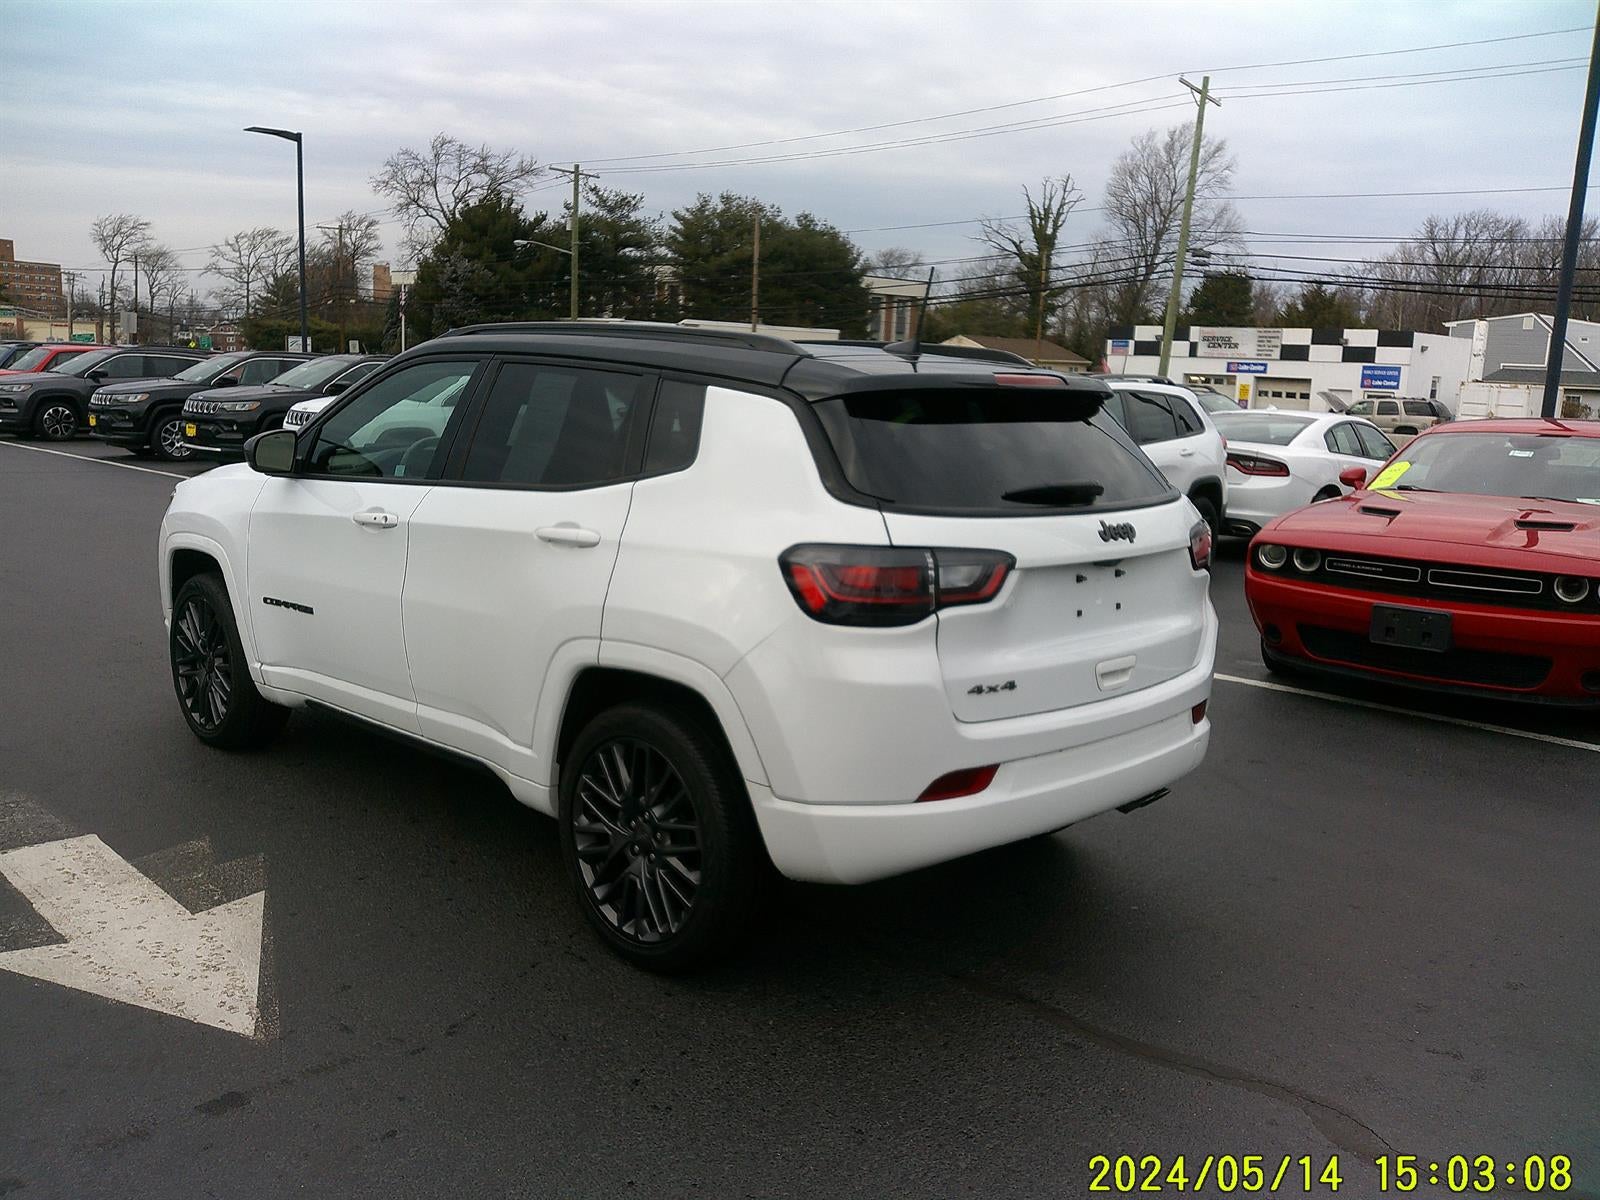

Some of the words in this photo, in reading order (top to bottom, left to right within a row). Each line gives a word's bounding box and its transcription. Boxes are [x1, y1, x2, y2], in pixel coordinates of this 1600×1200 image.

[1201, 335, 1233, 343] SERVICE
[1207, 342, 1240, 350] CENTER
[1098, 520, 1137, 544] Jeep
[967, 680, 1017, 696] 4x4
